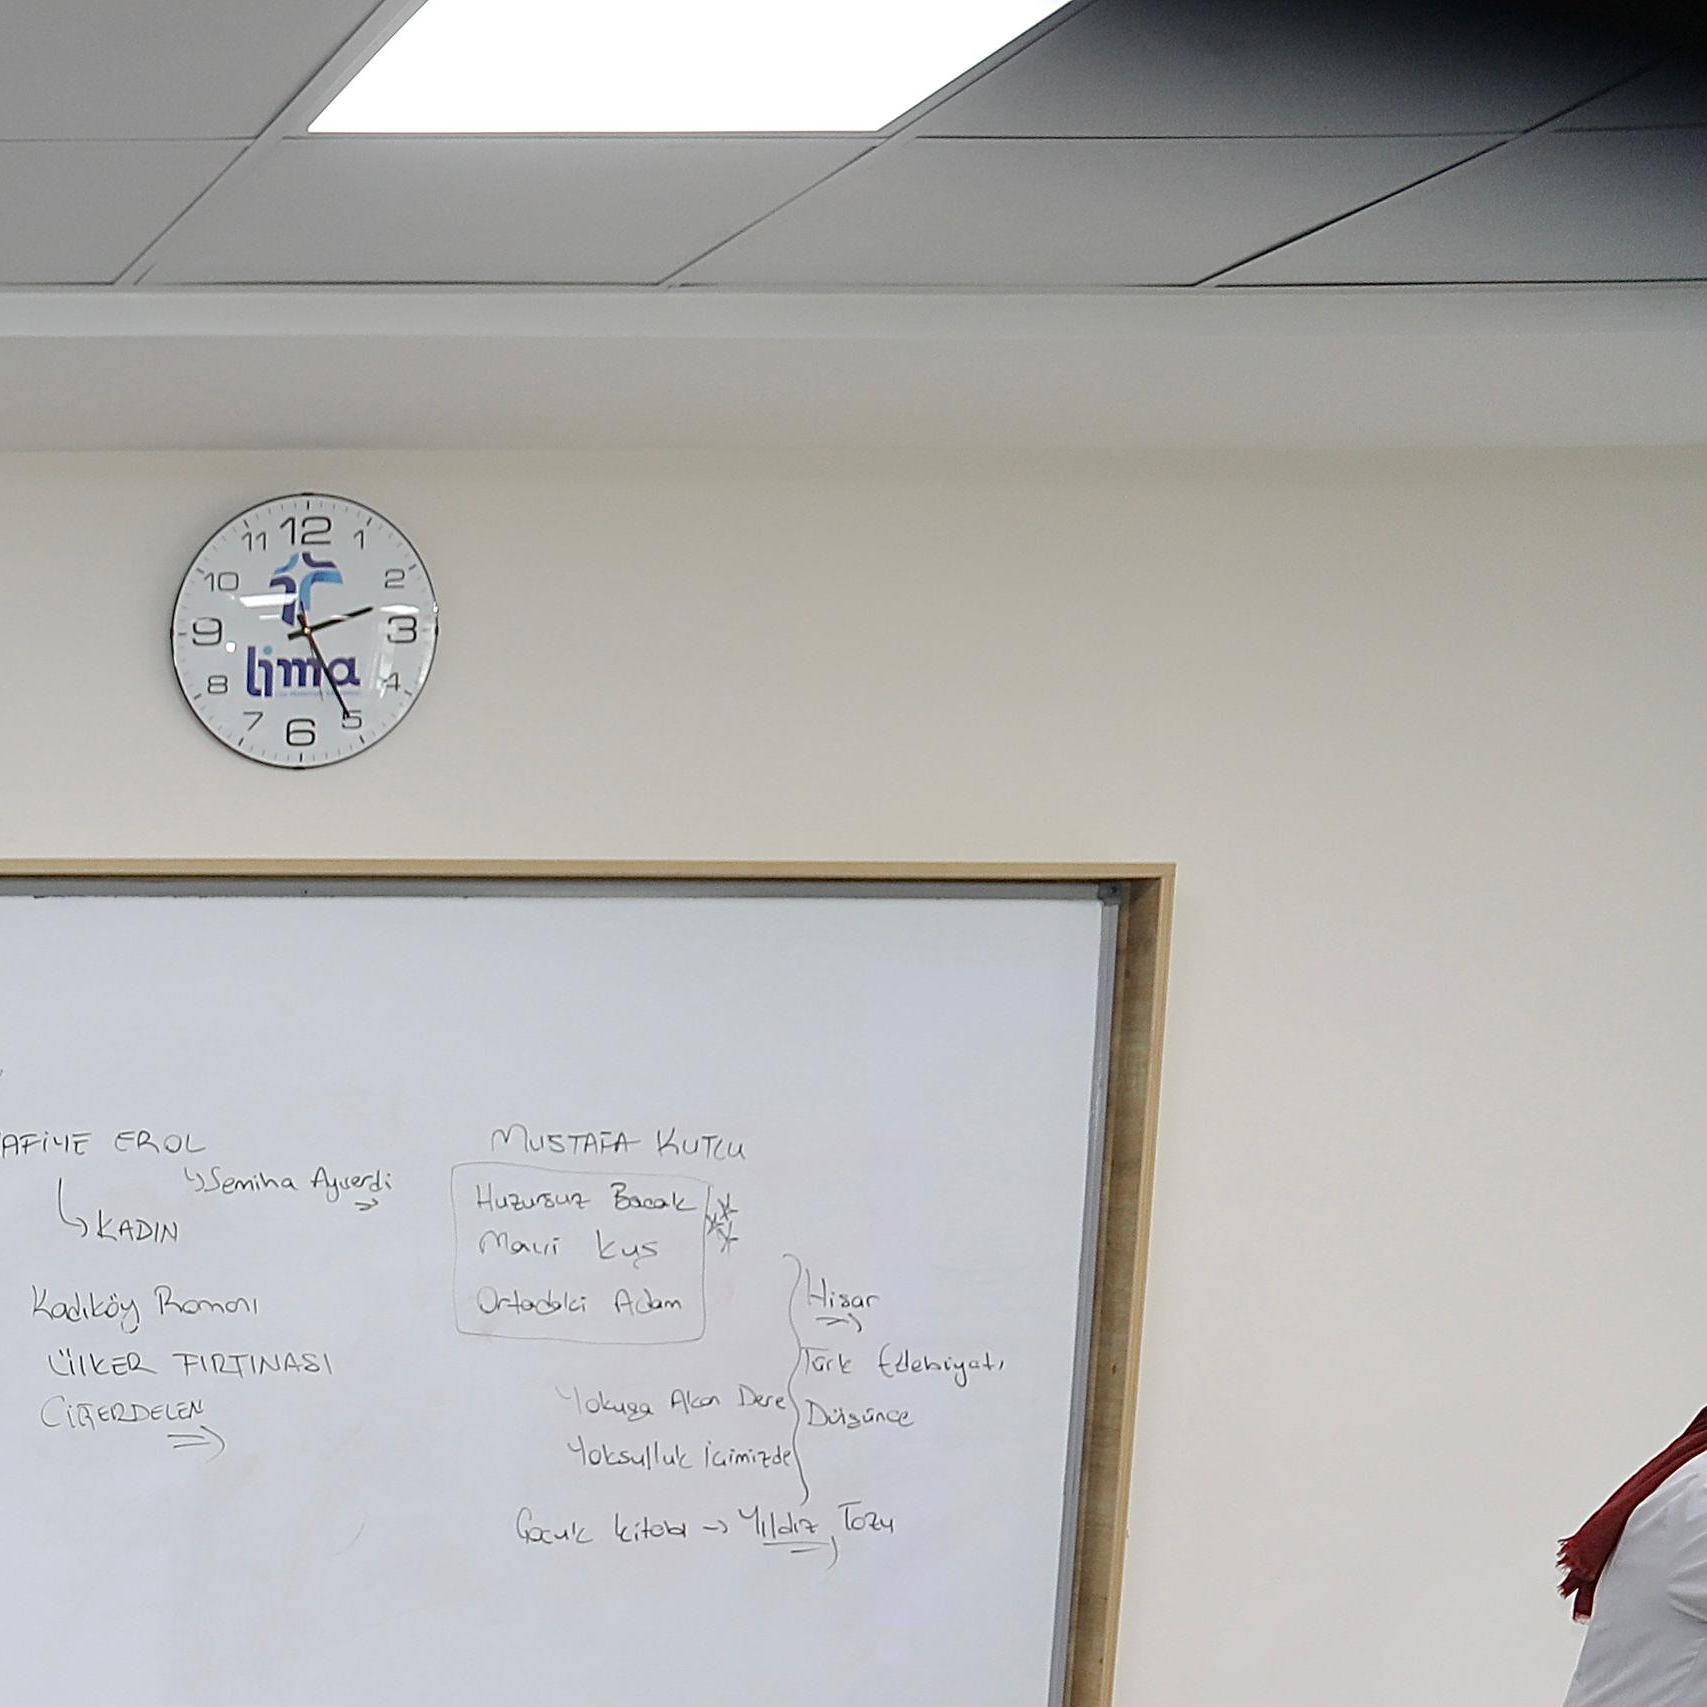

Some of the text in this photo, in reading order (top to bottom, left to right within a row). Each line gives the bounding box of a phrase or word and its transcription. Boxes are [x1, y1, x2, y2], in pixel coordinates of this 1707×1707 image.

[242, 531, 267, 551] 11
[279, 516, 332, 546] 12
[353, 529, 364, 549] 1
[203, 572, 239, 592] 10
[384, 568, 405, 589] 2
[192, 617, 223, 646] 9
[387, 615, 418, 644] 3
[207, 674, 229, 694] 8
[246, 645, 361, 698] lima
[382, 673, 401, 691] 4
[243, 711, 264, 731] 7
[286, 718, 316, 747] 6
[341, 709, 363, 730] 5
[114, 1130, 207, 1154] EROL
[491, 1123, 642, 1153] MUSTAFA
[204, 1166, 393, 1203] Semiha Ayverdi
[475, 1182, 592, 1212] Huzursuz
[96, 1208, 179, 1244] KADIN
[613, 1287, 683, 1316] Adam
[738, 1383, 787, 1410] Dere
